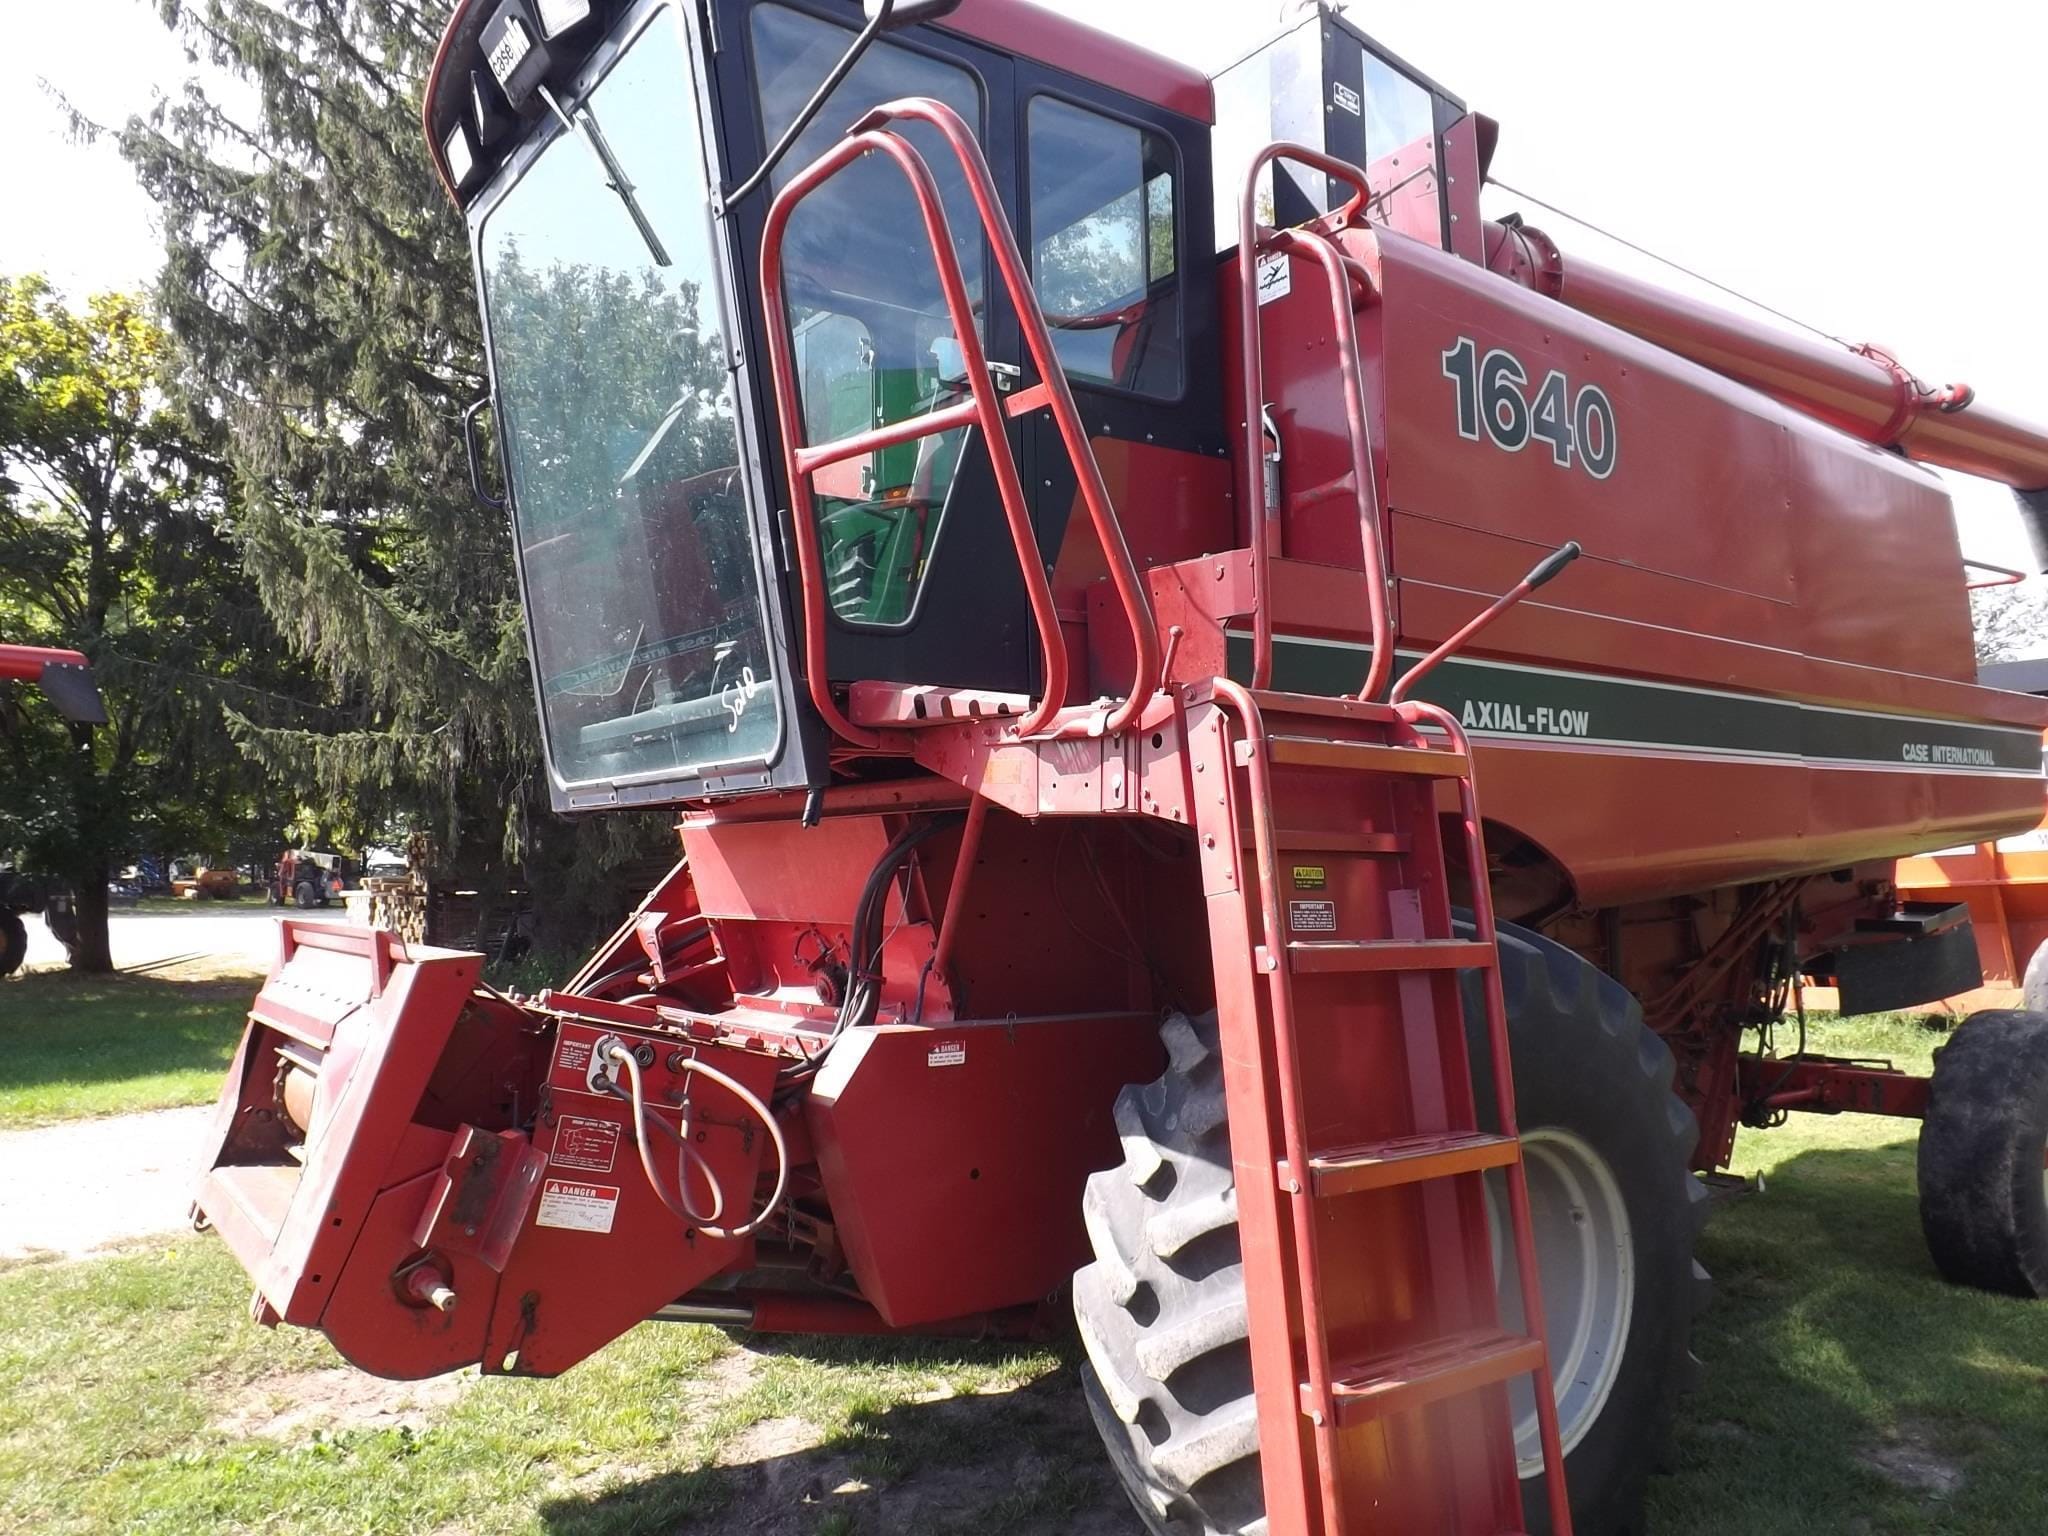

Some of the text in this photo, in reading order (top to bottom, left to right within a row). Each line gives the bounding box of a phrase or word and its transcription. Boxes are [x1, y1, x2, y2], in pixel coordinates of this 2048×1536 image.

[493, 44, 514, 77] case
[1442, 335, 1617, 480] 1640
[1462, 699, 1589, 737] AXIAL-FLOW
[1902, 743, 1995, 766] CASE INTERNATIONAL
[941, 1043, 960, 1053] DANGER
[562, 1185, 597, 1198] DANGER
